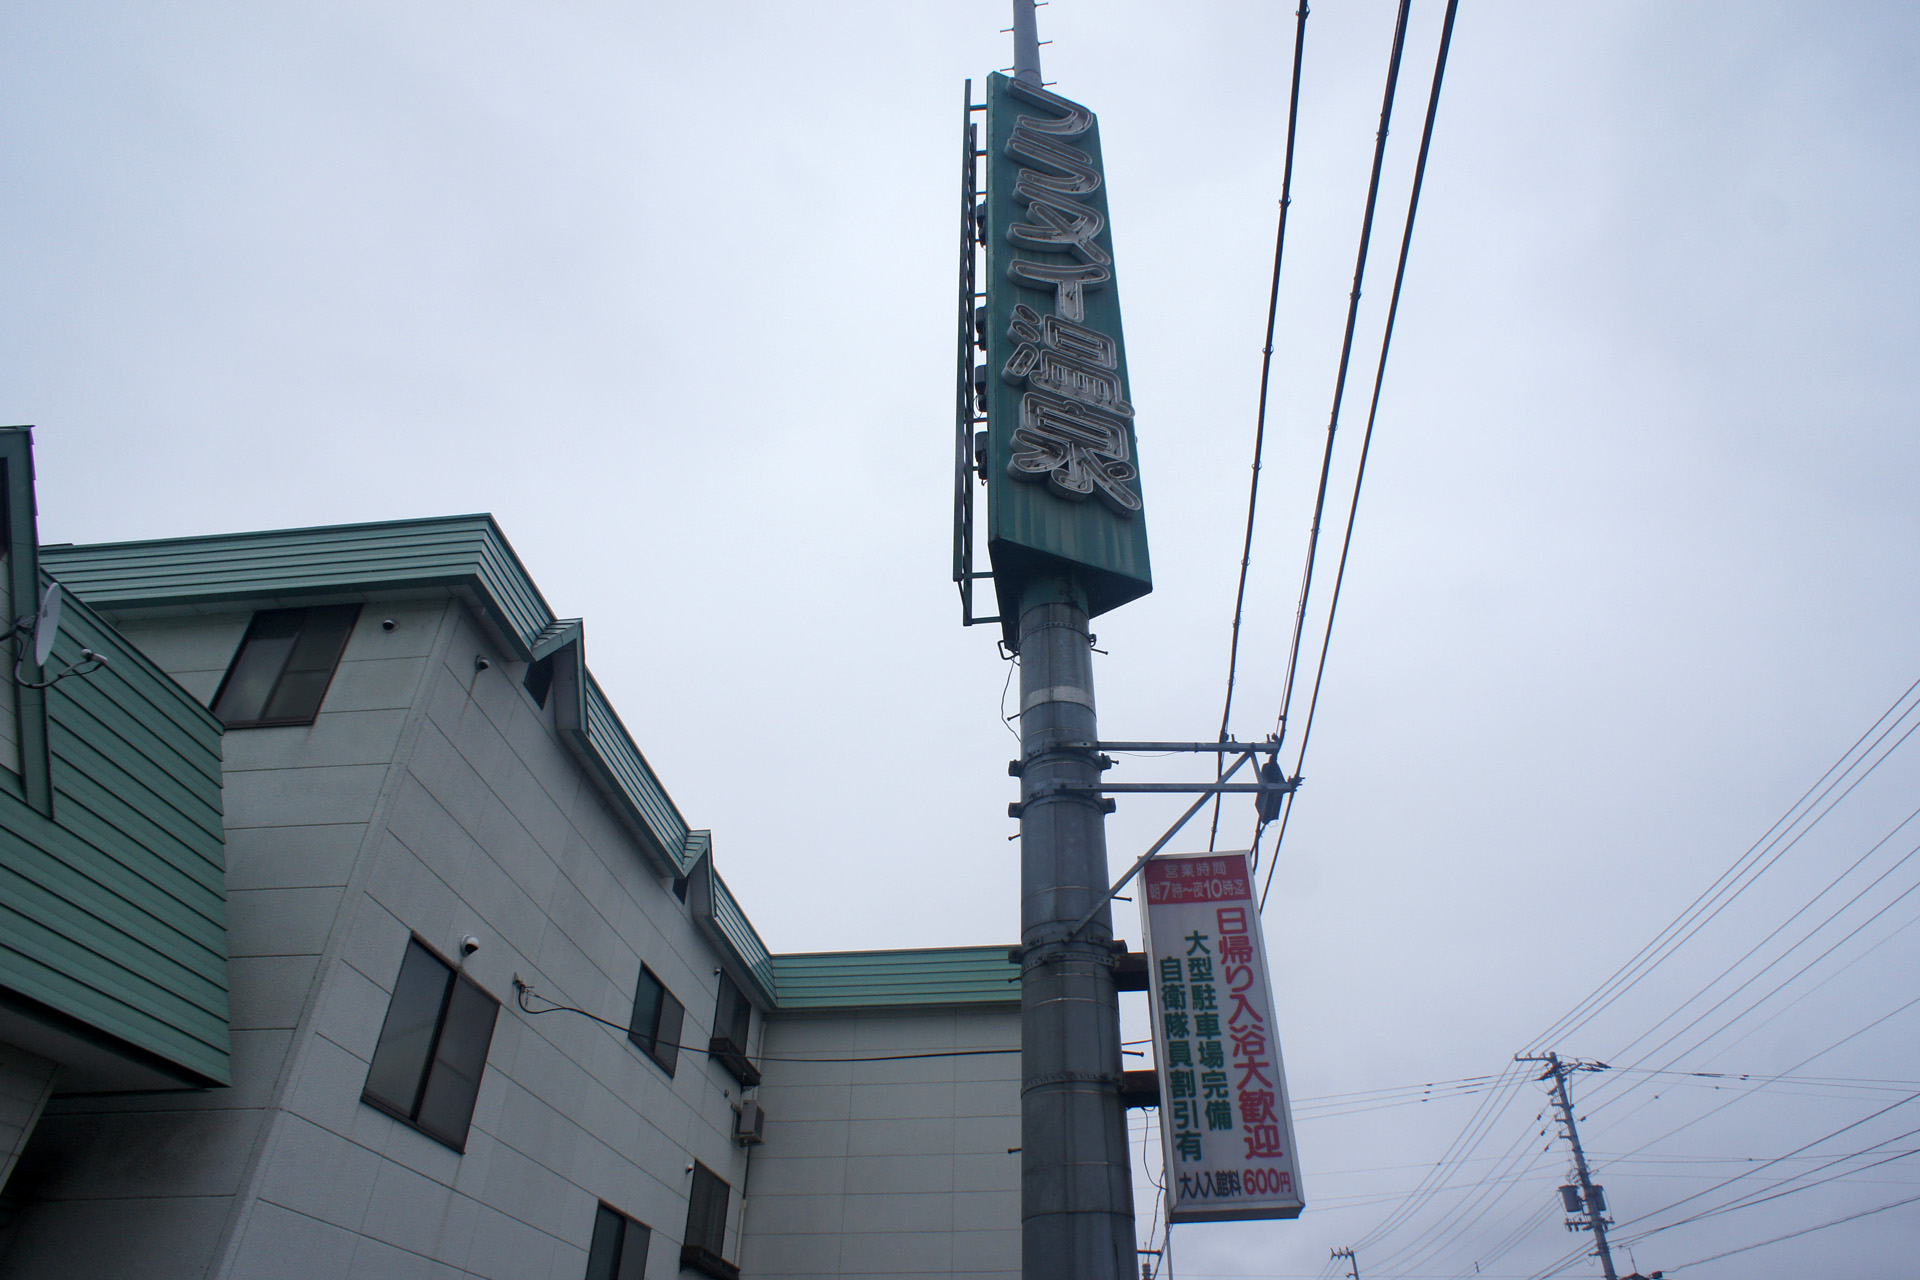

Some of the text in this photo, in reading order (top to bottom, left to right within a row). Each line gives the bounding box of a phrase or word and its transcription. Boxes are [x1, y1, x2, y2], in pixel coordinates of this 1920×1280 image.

[1002, 77, 1142, 517] フラヌイ温泉
[1164, 860, 1227, 879] 営業時間
[1159, 956, 1202, 1162] 自衛隊員割引有
[1184, 929, 1233, 1131] 大型駐車場完備
[1216, 907, 1283, 1160] 日帰り入浴大歓迎
